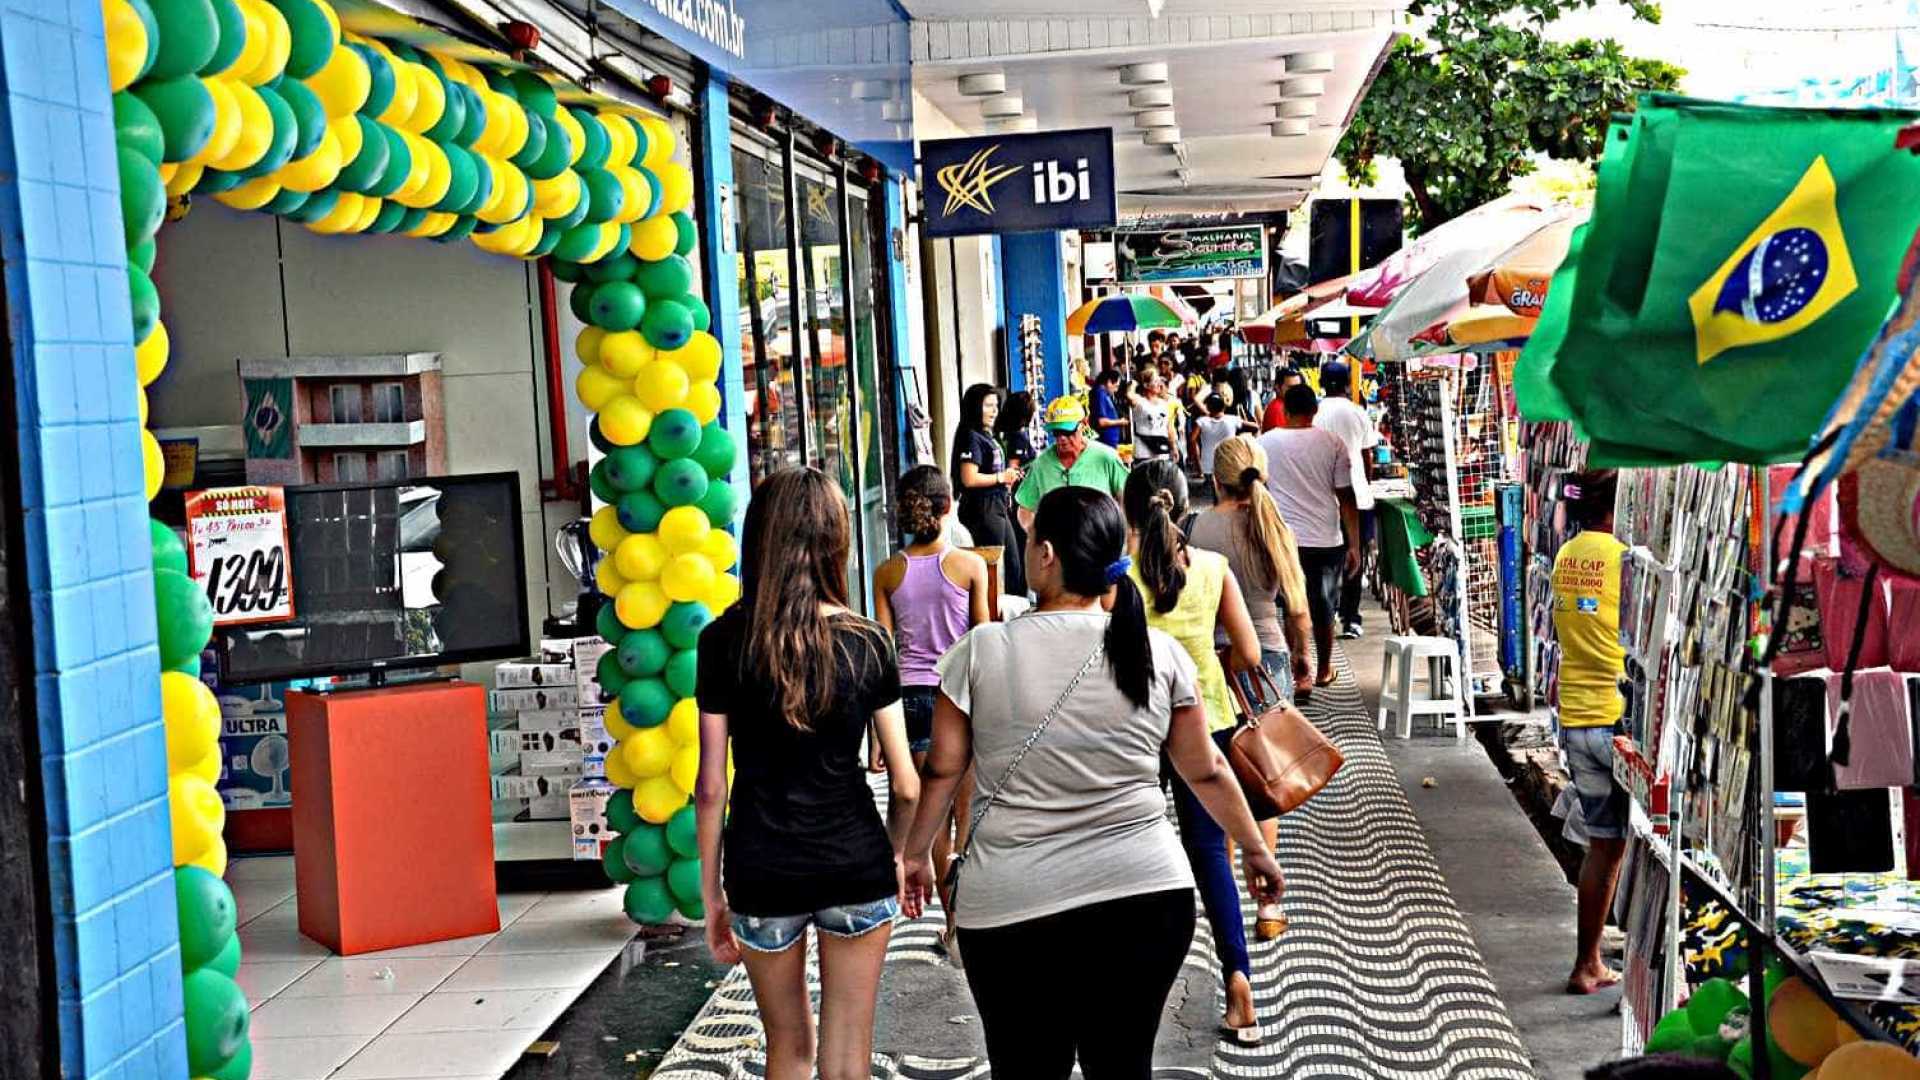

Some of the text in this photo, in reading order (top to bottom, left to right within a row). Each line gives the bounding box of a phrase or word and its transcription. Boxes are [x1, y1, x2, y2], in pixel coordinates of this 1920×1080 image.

[1033, 158, 1091, 204] ibi
[1192, 232, 1252, 242] MALHARIA
[1581, 559, 1605, 571] CAP
[206, 546, 284, 614] 1399
[226, 718, 279, 734] ULTRA
